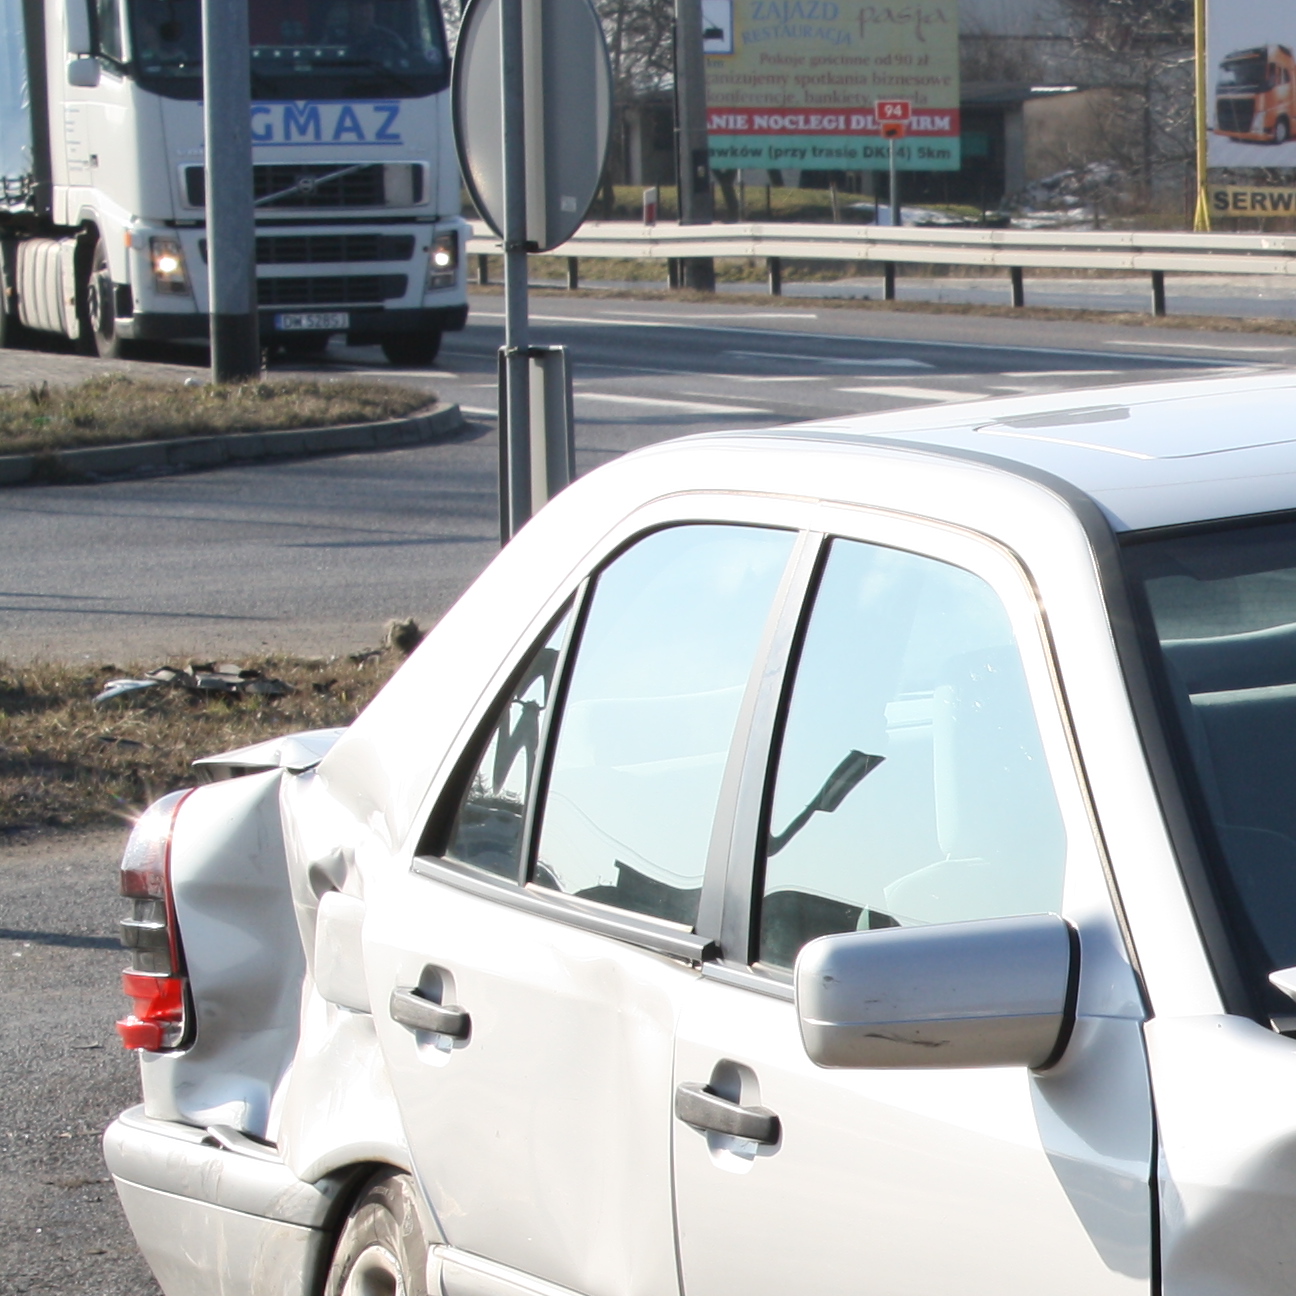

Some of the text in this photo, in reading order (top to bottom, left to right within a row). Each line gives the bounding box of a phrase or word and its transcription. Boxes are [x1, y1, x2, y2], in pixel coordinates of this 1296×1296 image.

[752, 0, 839, 23] ZAJAZD
[872, 72, 952, 87] biznesowe
[884, 104, 902, 118] 94
[753, 116, 846, 130] NOCLEGI
